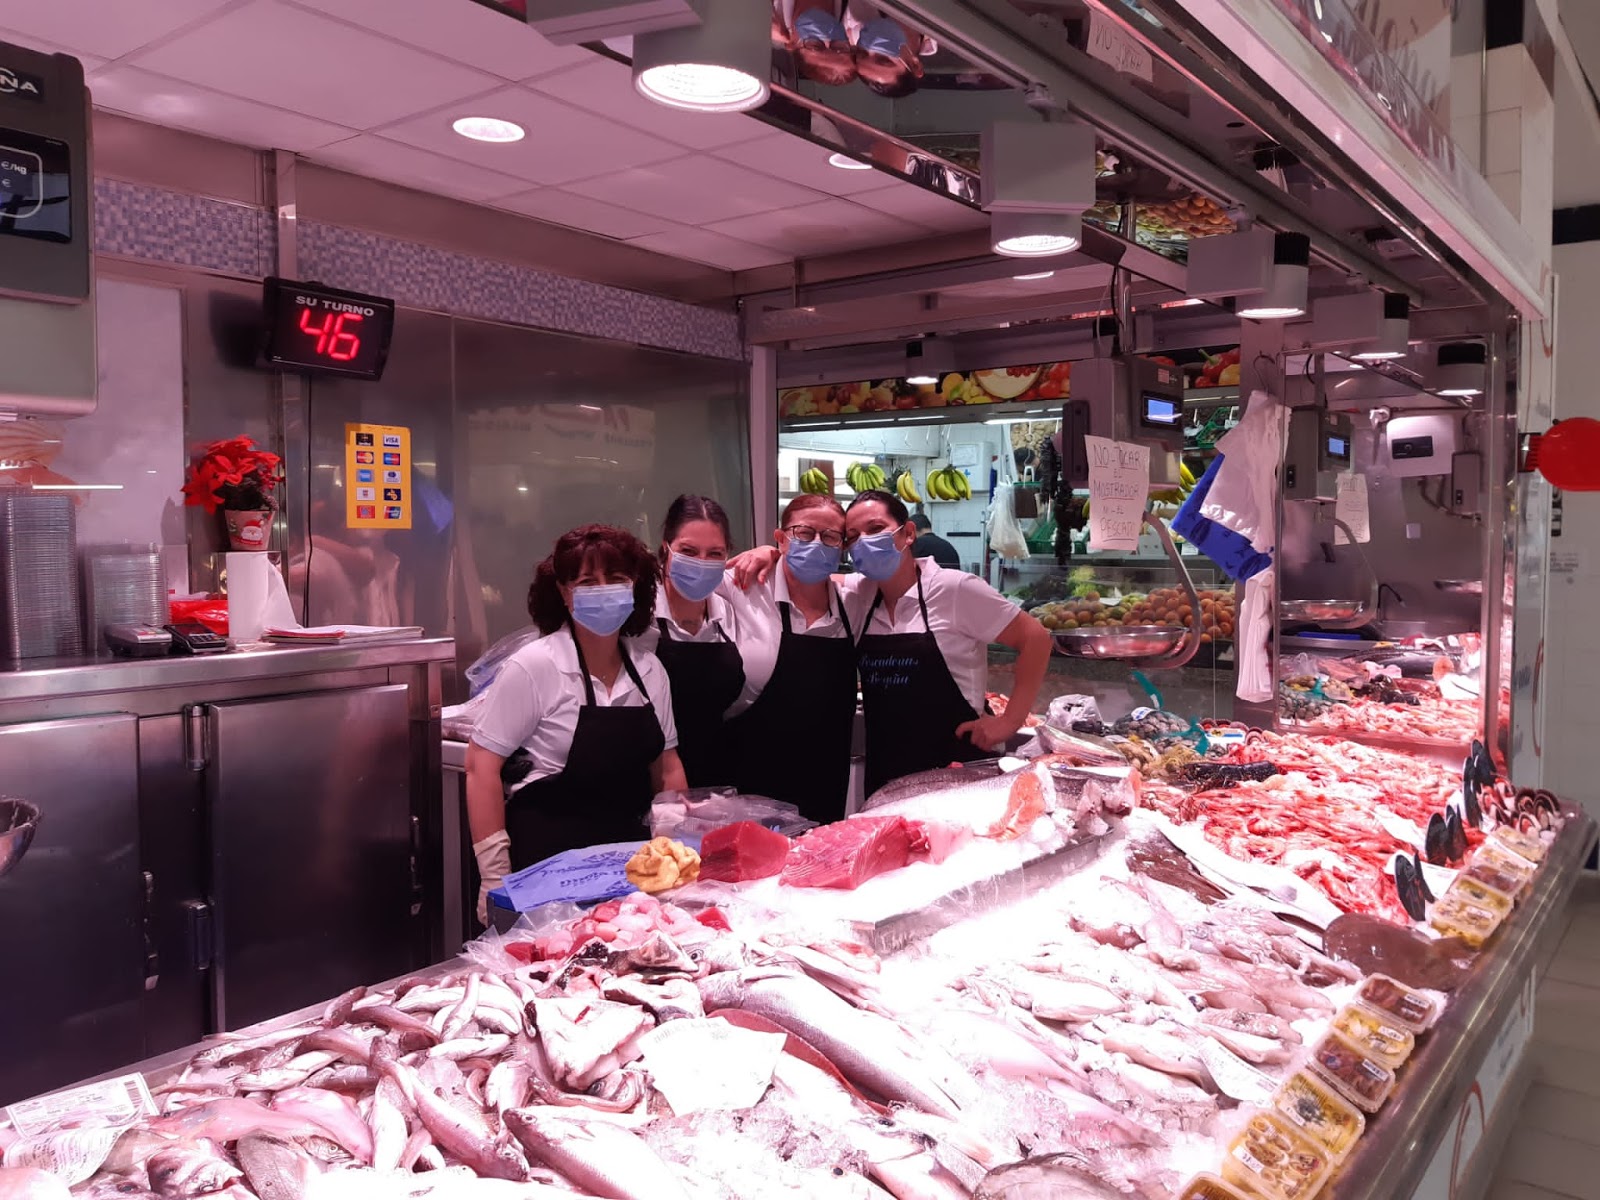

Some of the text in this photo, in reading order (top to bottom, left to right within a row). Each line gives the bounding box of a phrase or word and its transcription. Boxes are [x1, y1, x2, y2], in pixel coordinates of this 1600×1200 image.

[295, 295, 375, 317] SU TURNO
[299, 307, 364, 361] 46
